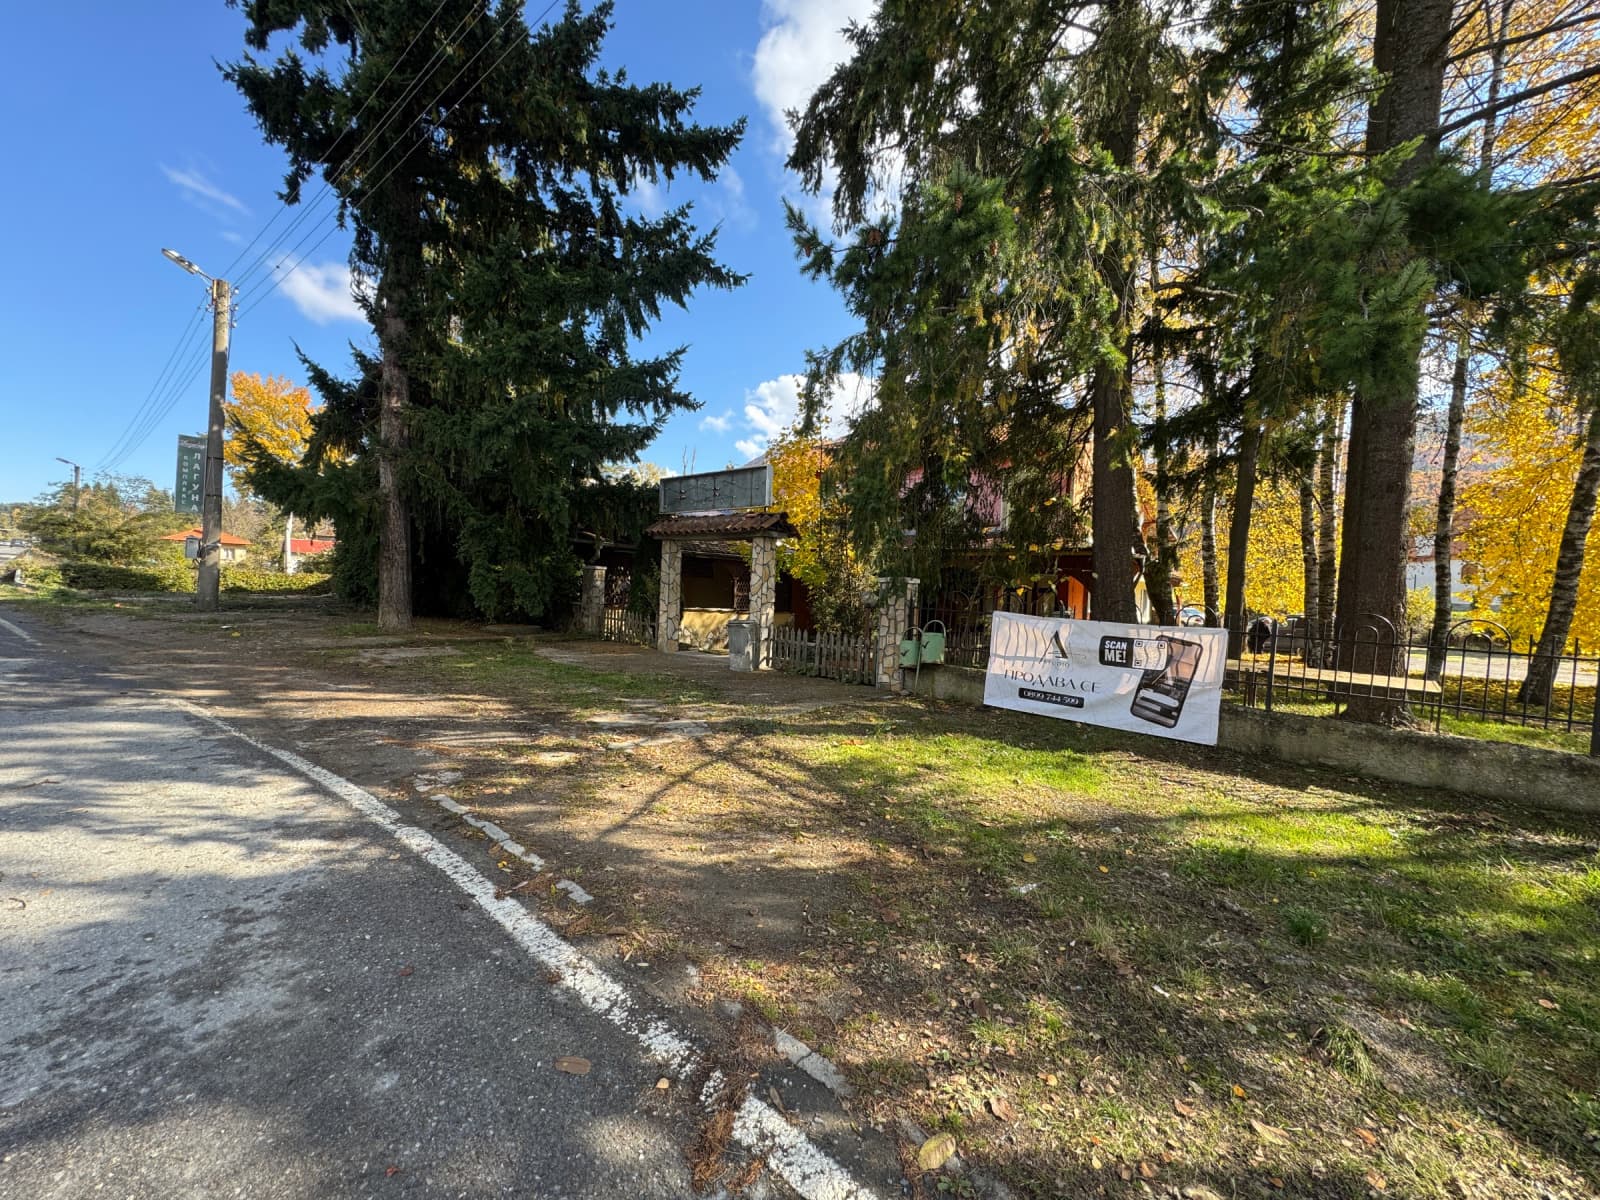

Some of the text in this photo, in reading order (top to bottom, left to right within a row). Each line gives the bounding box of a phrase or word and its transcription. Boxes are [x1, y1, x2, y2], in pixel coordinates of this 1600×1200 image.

[191, 452, 201, 512] ЛАГУНА
[1104, 640, 1128, 651] SCAN
[1104, 650, 1127, 664] ME!
[1004, 669, 1103, 694] ПРОДАВА СЕ
